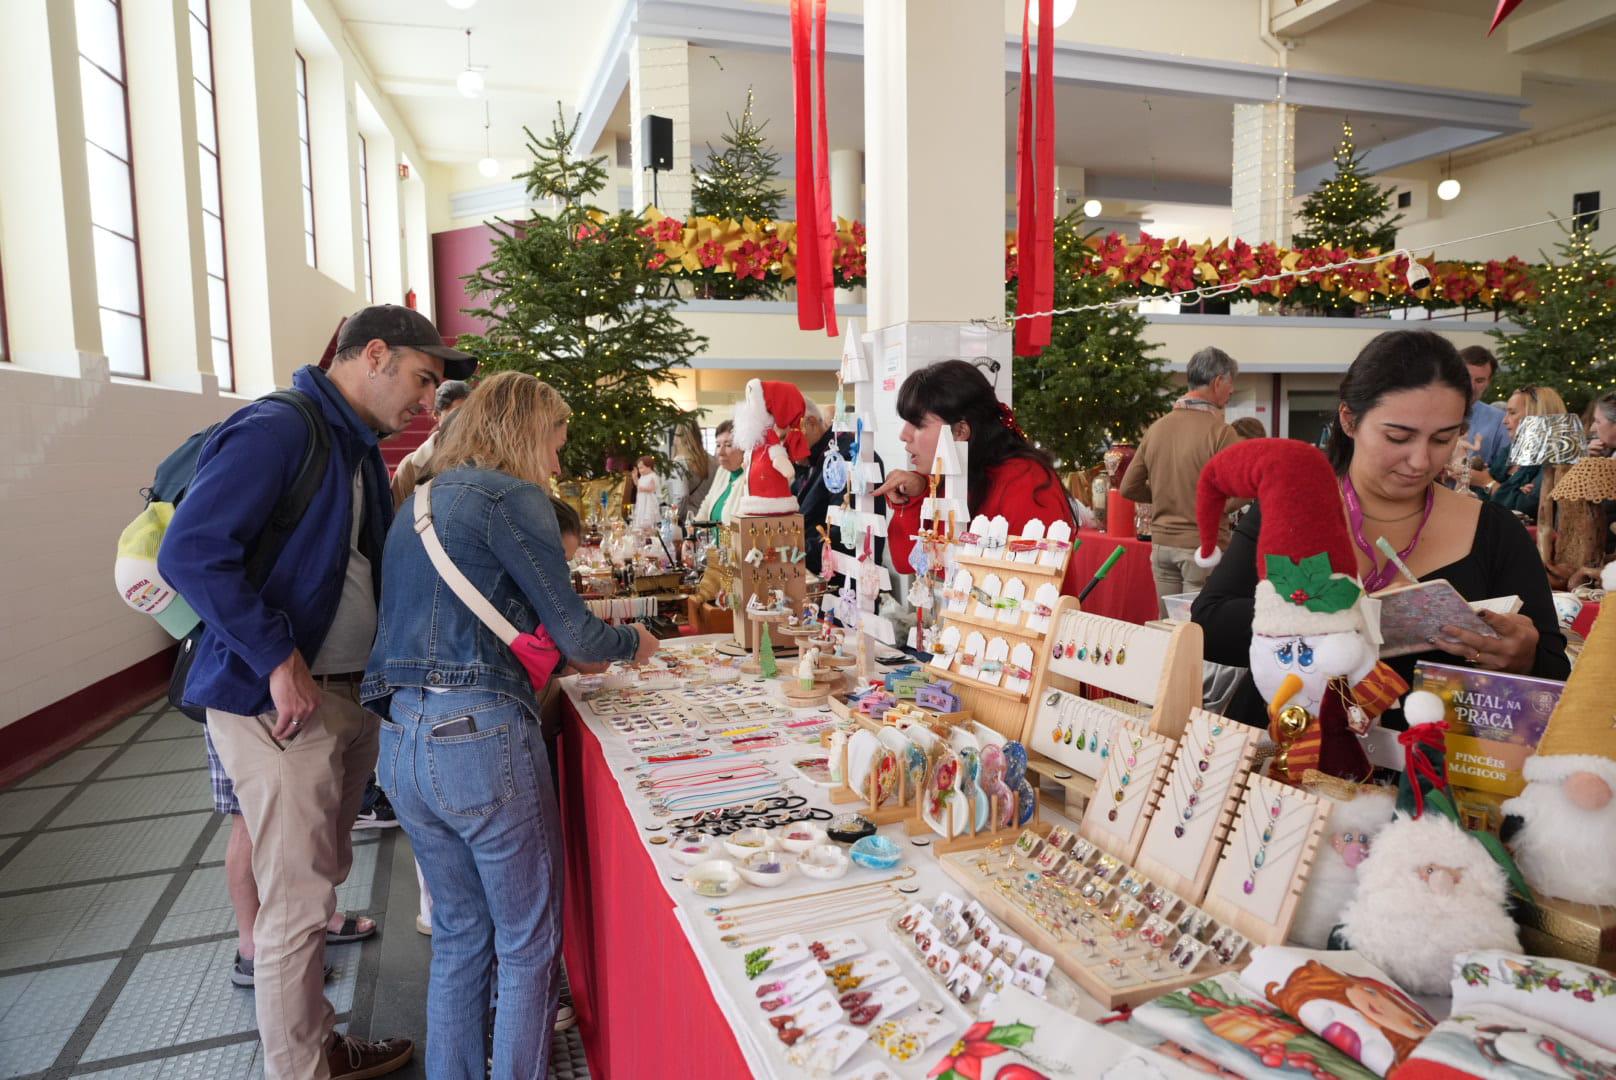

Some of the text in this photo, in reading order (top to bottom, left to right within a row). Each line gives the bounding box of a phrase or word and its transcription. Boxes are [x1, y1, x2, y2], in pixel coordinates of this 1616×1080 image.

[1452, 690, 1521, 711] NATAL NA
[1455, 707, 1513, 729] PRAÇA
[1449, 763, 1506, 781] MÁGICOS
